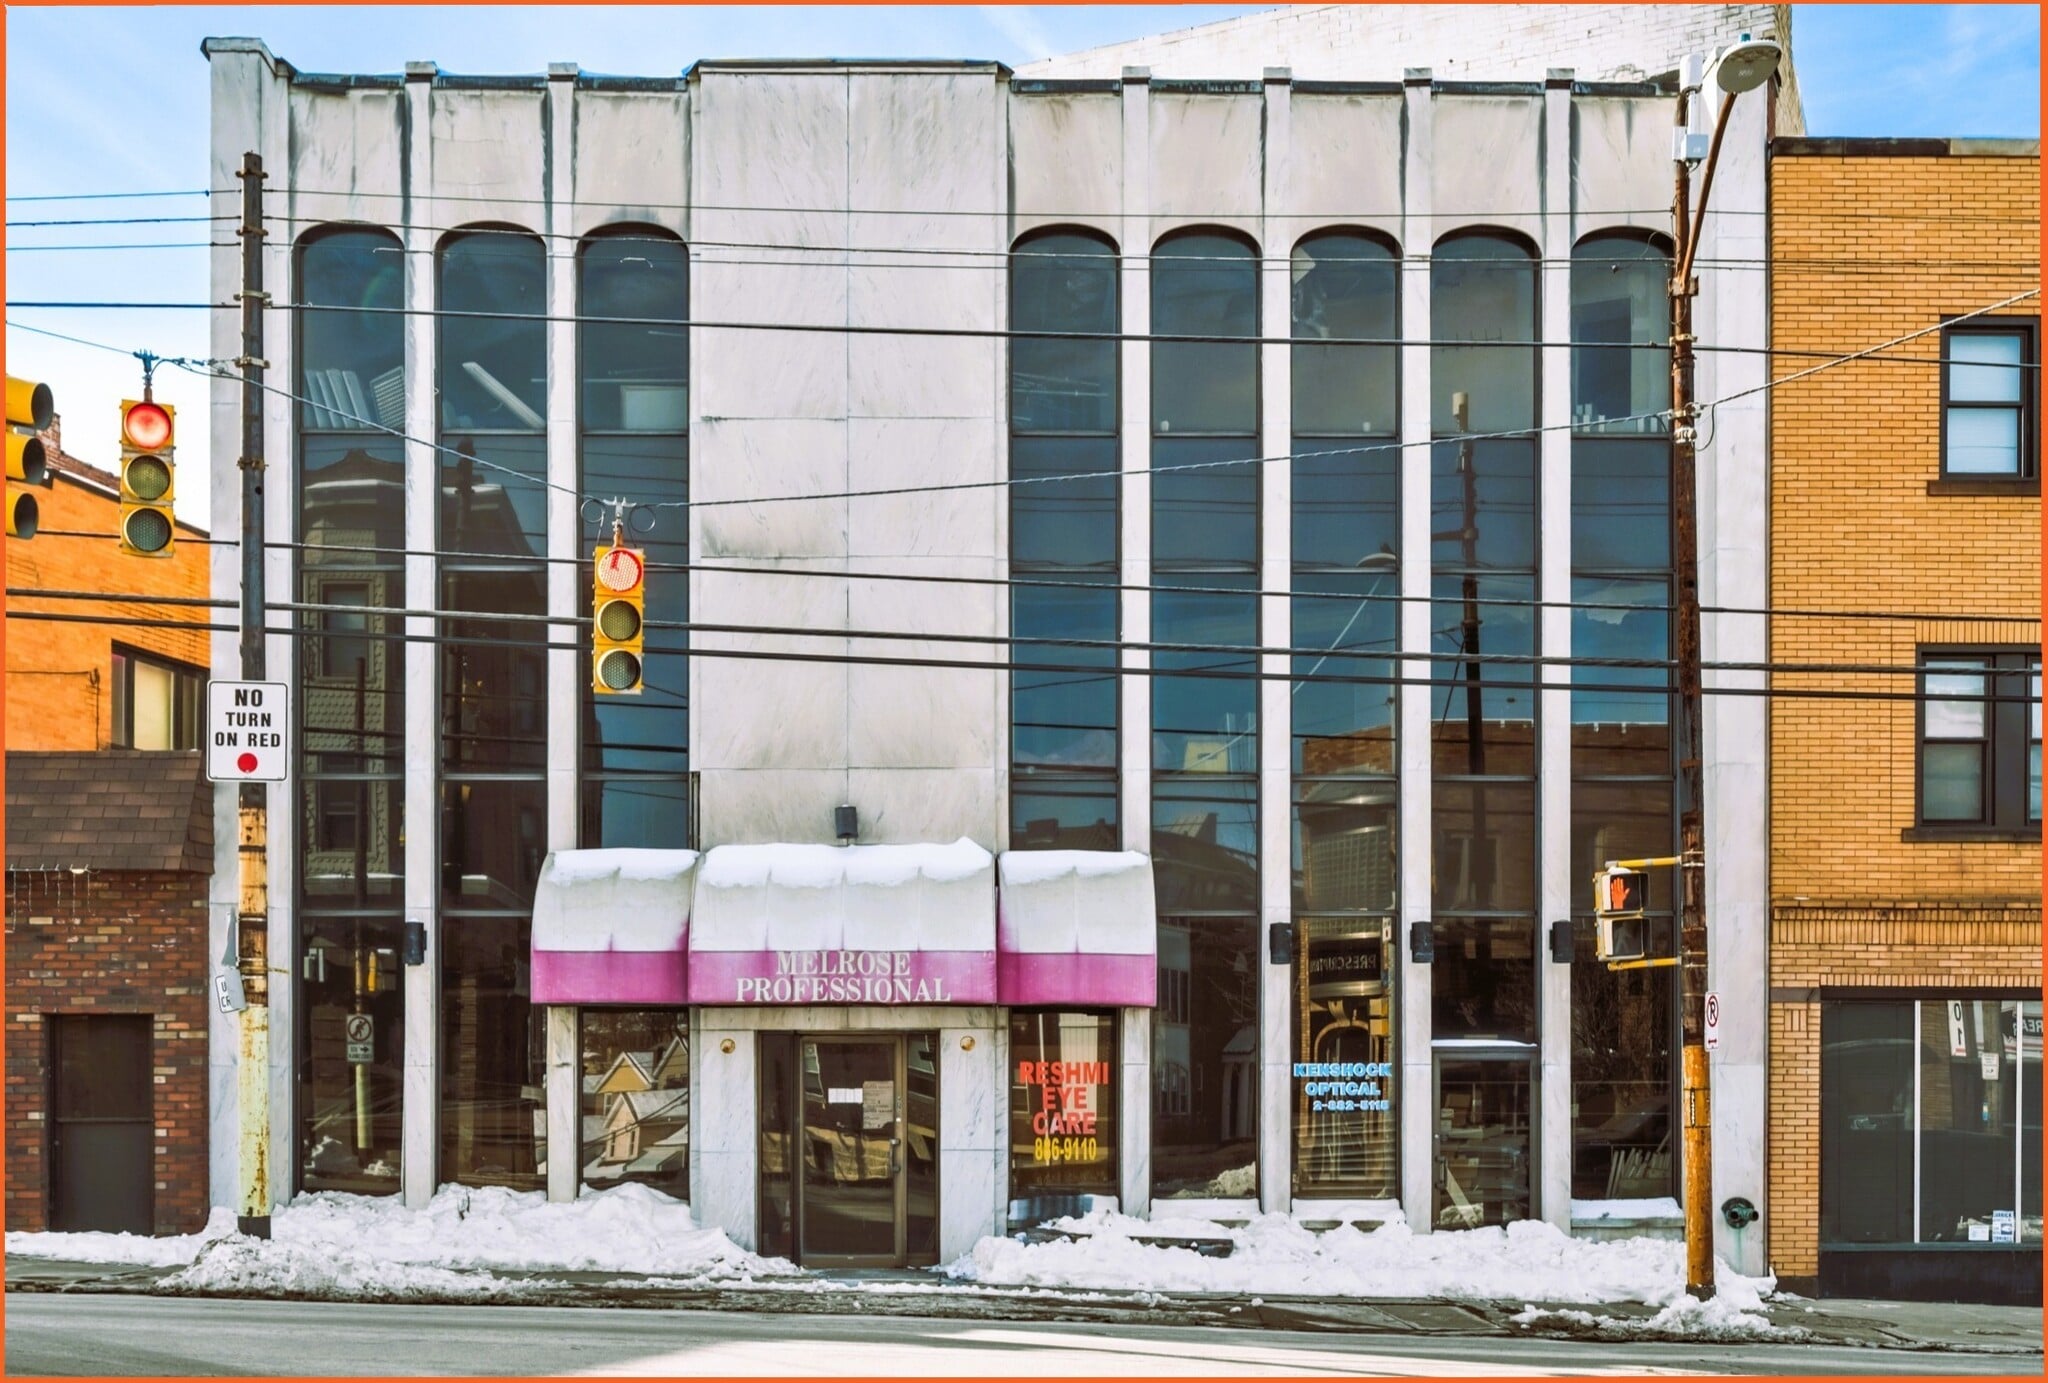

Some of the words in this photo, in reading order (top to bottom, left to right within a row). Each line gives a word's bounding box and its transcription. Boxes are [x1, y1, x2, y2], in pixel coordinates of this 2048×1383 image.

[234, 688, 263, 707] NO
[225, 712, 271, 727] TURN
[215, 732, 238, 747] ON
[247, 733, 281, 748] RED
[776, 950, 911, 976] MELROSE
[735, 976, 952, 1002] PROFESSIONAL
[1019, 1061, 1109, 1084] RESHMI
[1293, 1062, 1393, 1077] KENSHOCK
[1042, 1086, 1088, 1110] EYE
[1304, 1081, 1382, 1096] OPTICAL
[1032, 1111, 1097, 1135] CARE
